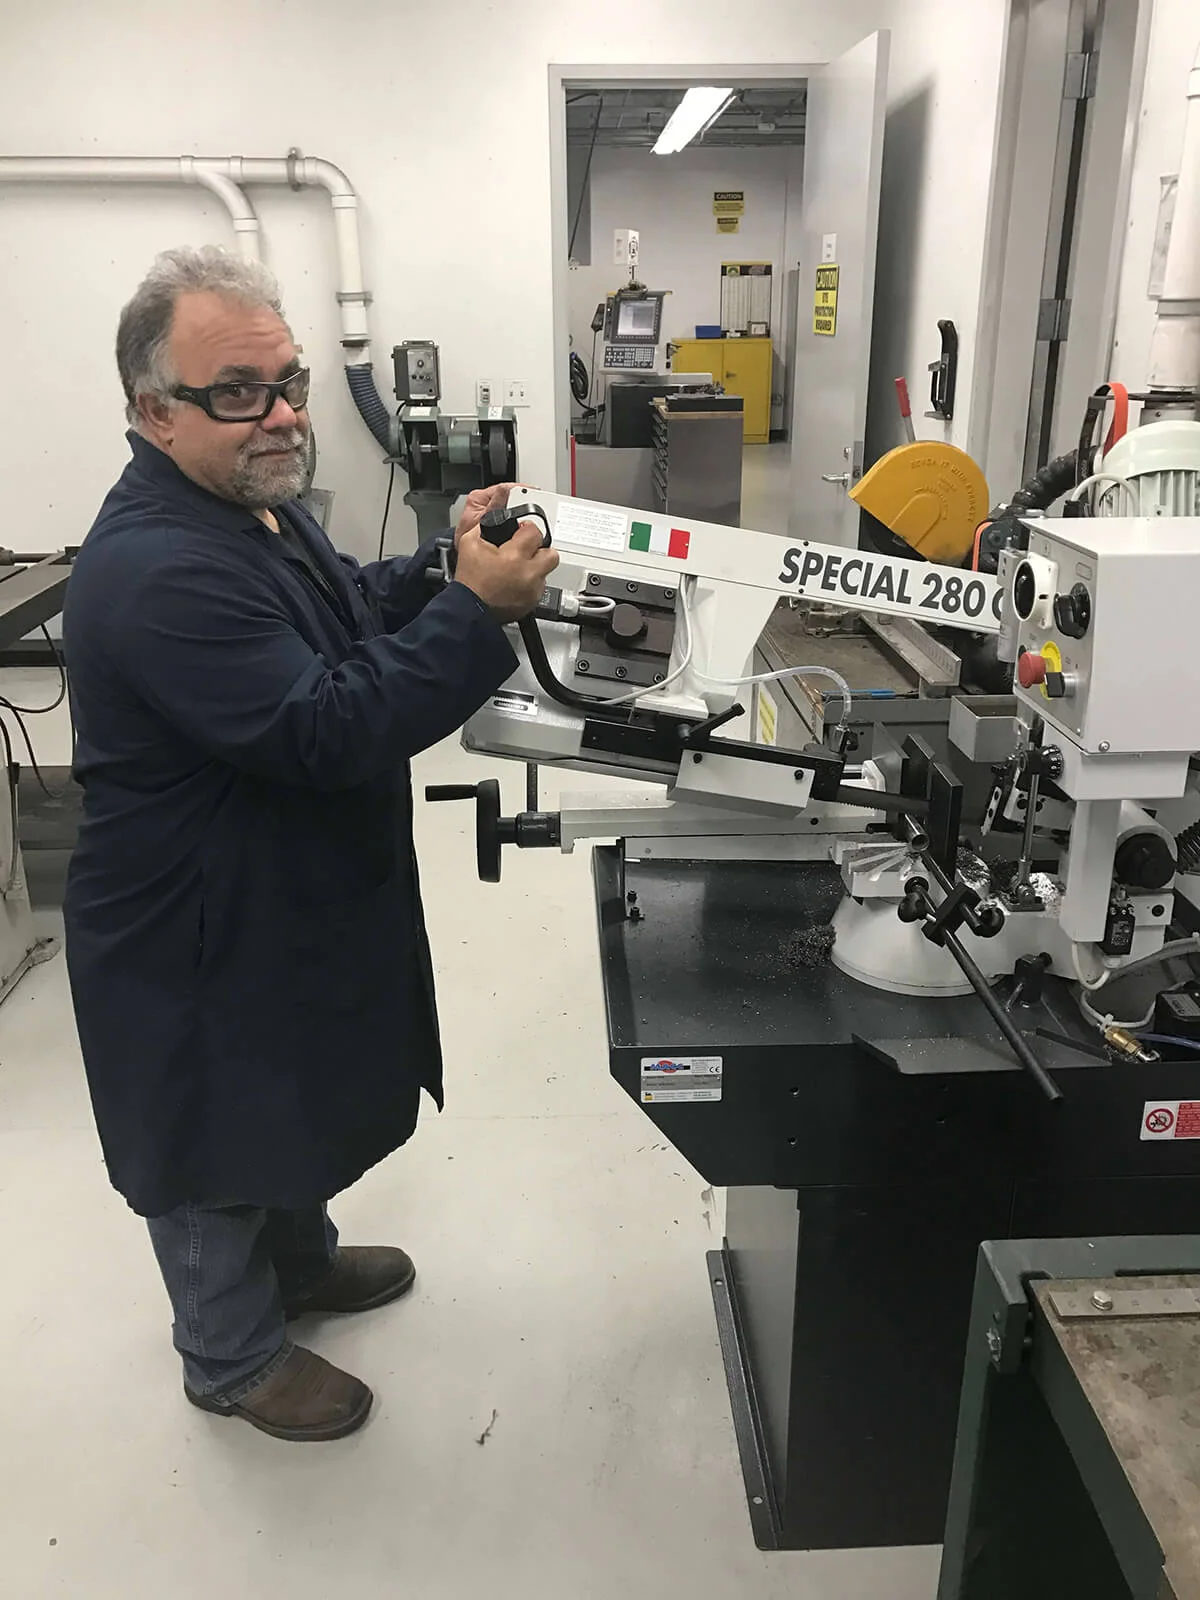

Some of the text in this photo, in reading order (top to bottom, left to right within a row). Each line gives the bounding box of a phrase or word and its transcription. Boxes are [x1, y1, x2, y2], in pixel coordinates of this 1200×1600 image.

[816, 270, 837, 289] CAUTION
[778, 548, 912, 604] SPECIAL
[918, 573, 986, 617] 280
